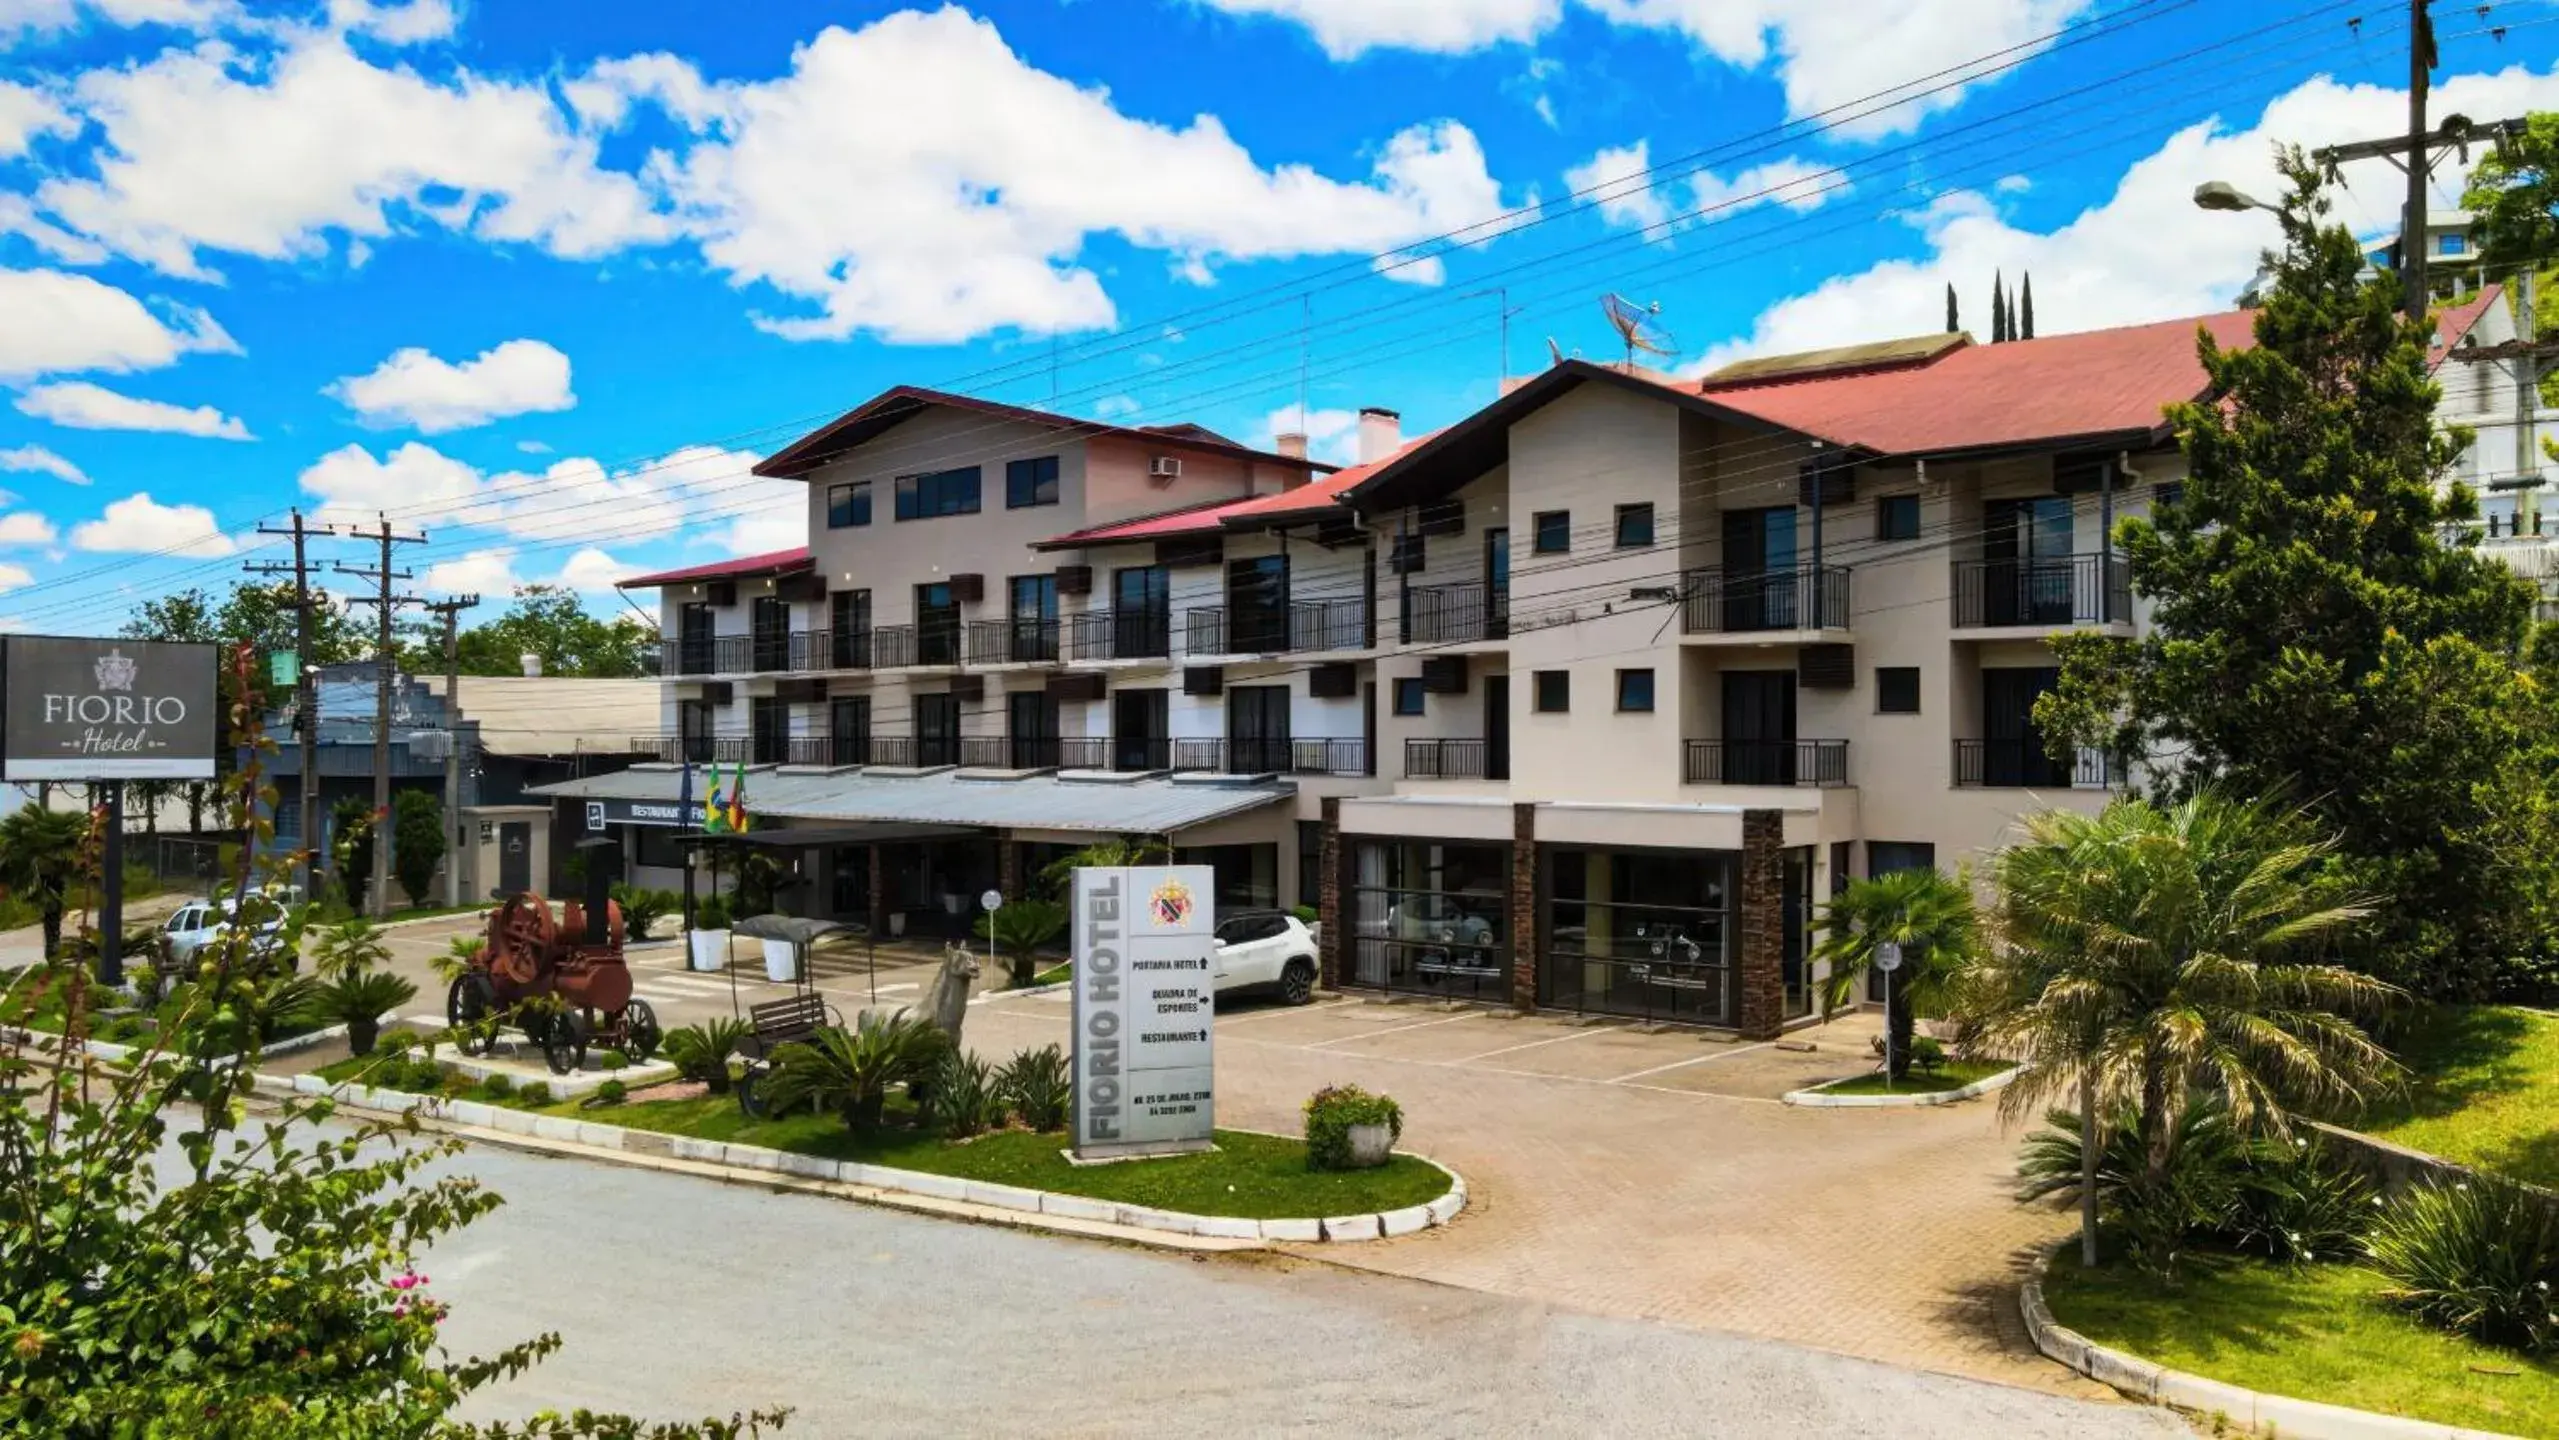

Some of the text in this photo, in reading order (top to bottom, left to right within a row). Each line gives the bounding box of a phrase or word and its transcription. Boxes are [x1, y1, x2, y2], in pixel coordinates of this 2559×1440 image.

[43, 694, 186, 725] FIORIO
[82, 726, 146, 754] Hotel
[1132, 960, 1198, 970] PORTARIA HOTEL
[1187, 988, 1198, 998] DE
[1088, 875, 1120, 1140] FIORIO HOTEL
[1157, 1003, 1198, 1014] ESPORTES
[1141, 1031, 1198, 1043] RESTAURANTE
